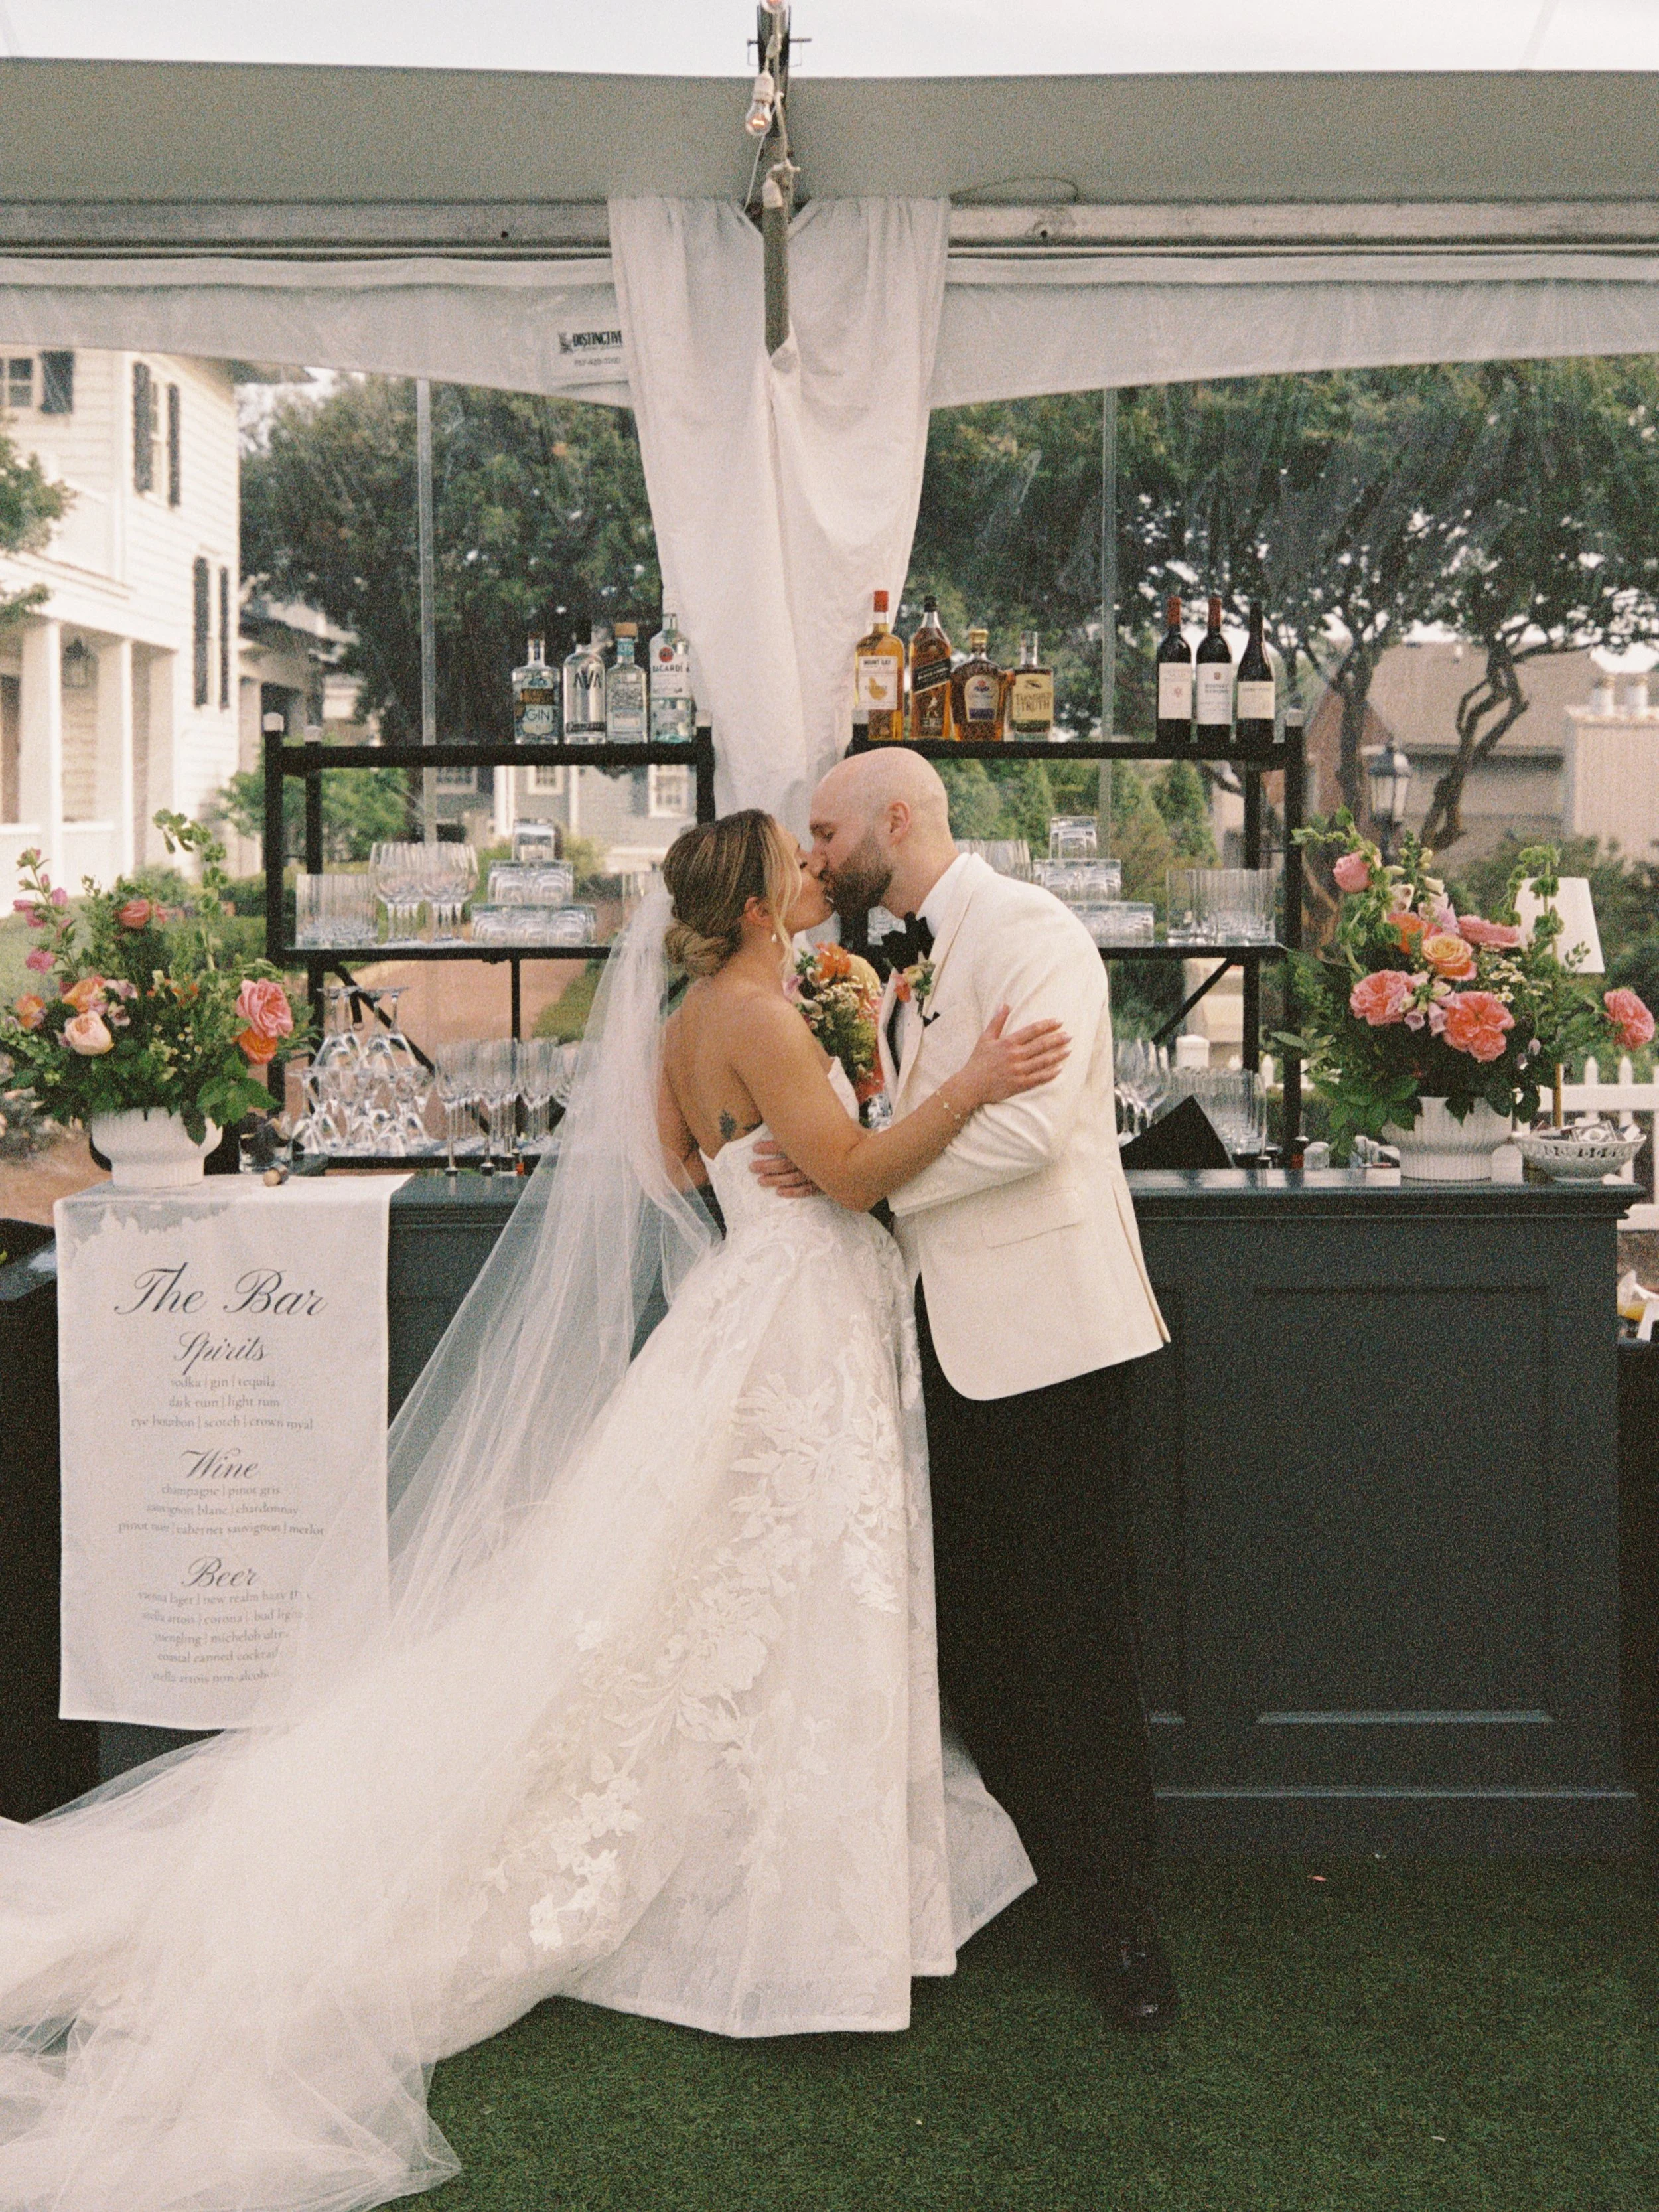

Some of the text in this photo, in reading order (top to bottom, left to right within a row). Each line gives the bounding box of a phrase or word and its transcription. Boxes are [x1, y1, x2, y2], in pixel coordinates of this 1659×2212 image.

[527, 708, 549, 721] GIN
[1022, 700, 1050, 713] TRUTH
[114, 1262, 328, 1317] The Bar
[173, 1331, 269, 1376] Spirits
[171, 1376, 275, 1390] vodka gin tequila
[169, 1396, 190, 1408] dark
[228, 1394, 253, 1410] light
[153, 1414, 194, 1428] bourbon
[204, 1415, 240, 1427] scotch
[249, 1418, 283, 1427] crown
[287, 1418, 313, 1432] royal
[179, 1447, 259, 1479] Wine
[161, 1483, 281, 1499] champagne pinot gris
[198, 1503, 227, 1515] blanc
[236, 1502, 298, 1518] chardonnay
[117, 1522, 147, 1534] pinot
[176, 1522, 223, 1535] cabernet
[228, 1522, 281, 1536] sauvignon
[289, 1522, 325, 1536] merlot
[181, 1556, 257, 1587] Beer
[169, 1593, 193, 1608] lager
[204, 1595, 224, 1605] new
[229, 1591, 258, 1603] realm
[204, 1615, 242, 1625] corona
[254, 1609, 274, 1621] bud
[277, 1608, 303, 1623] lig
[210, 1630, 261, 1643] michelob
